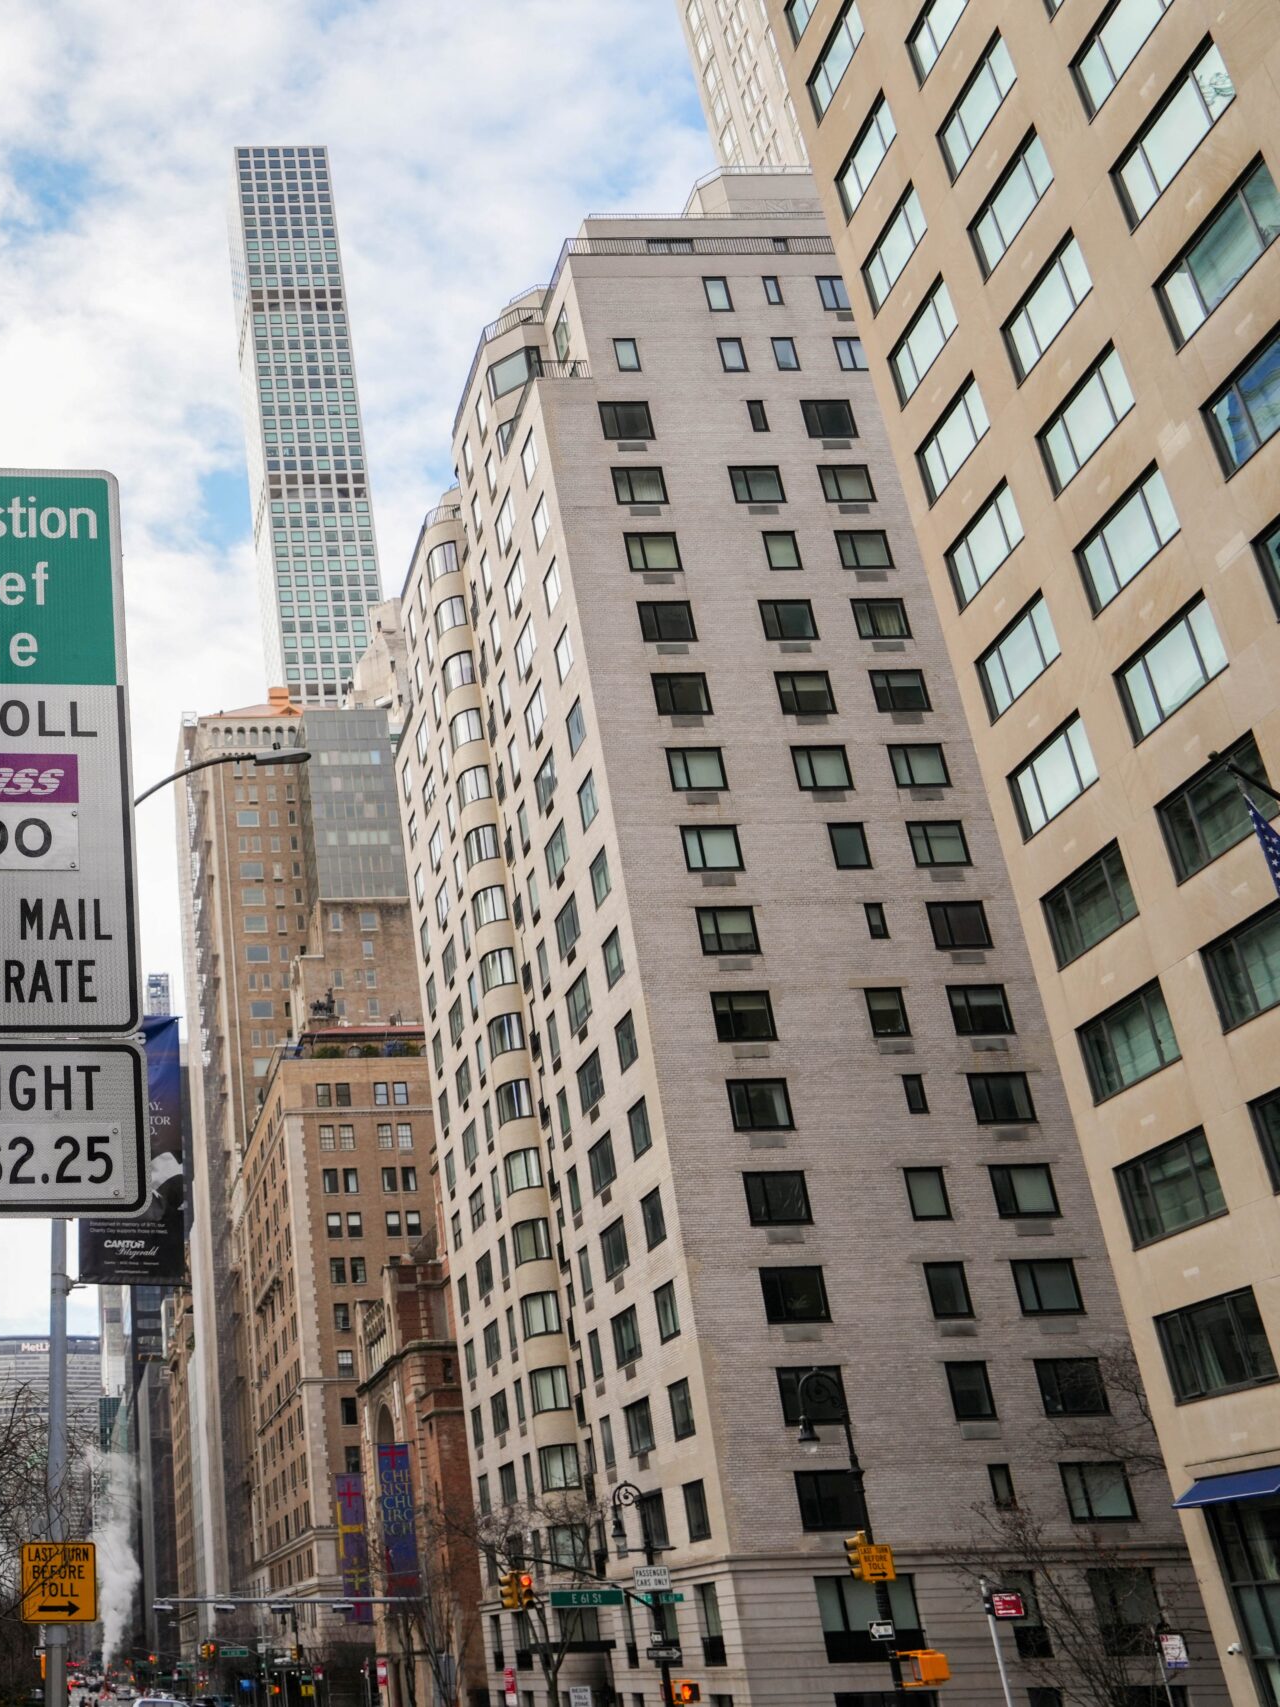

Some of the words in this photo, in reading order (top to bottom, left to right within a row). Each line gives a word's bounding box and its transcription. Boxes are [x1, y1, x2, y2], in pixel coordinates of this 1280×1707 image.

[20, 898, 113, 941] MAIL
[4, 959, 98, 1003] RATE
[103, 1239, 146, 1249] CANTOR
[21, 1342, 50, 1352] MetLi
[28, 1547, 53, 1561] LAST
[863, 1554, 888, 1563] BEFORE
[868, 1562, 886, 1570] TOLL
[32, 1565, 86, 1580] BEFORE
[635, 1568, 667, 1577] PASSENGER
[637, 1579, 652, 1587] CARS
[654, 1578, 668, 1586] ONLY
[40, 1582, 79, 1597] TOLL
[571, 1593, 579, 1604] E
[580, 1593, 590, 1604] 61
[592, 1592, 602, 1604] St
